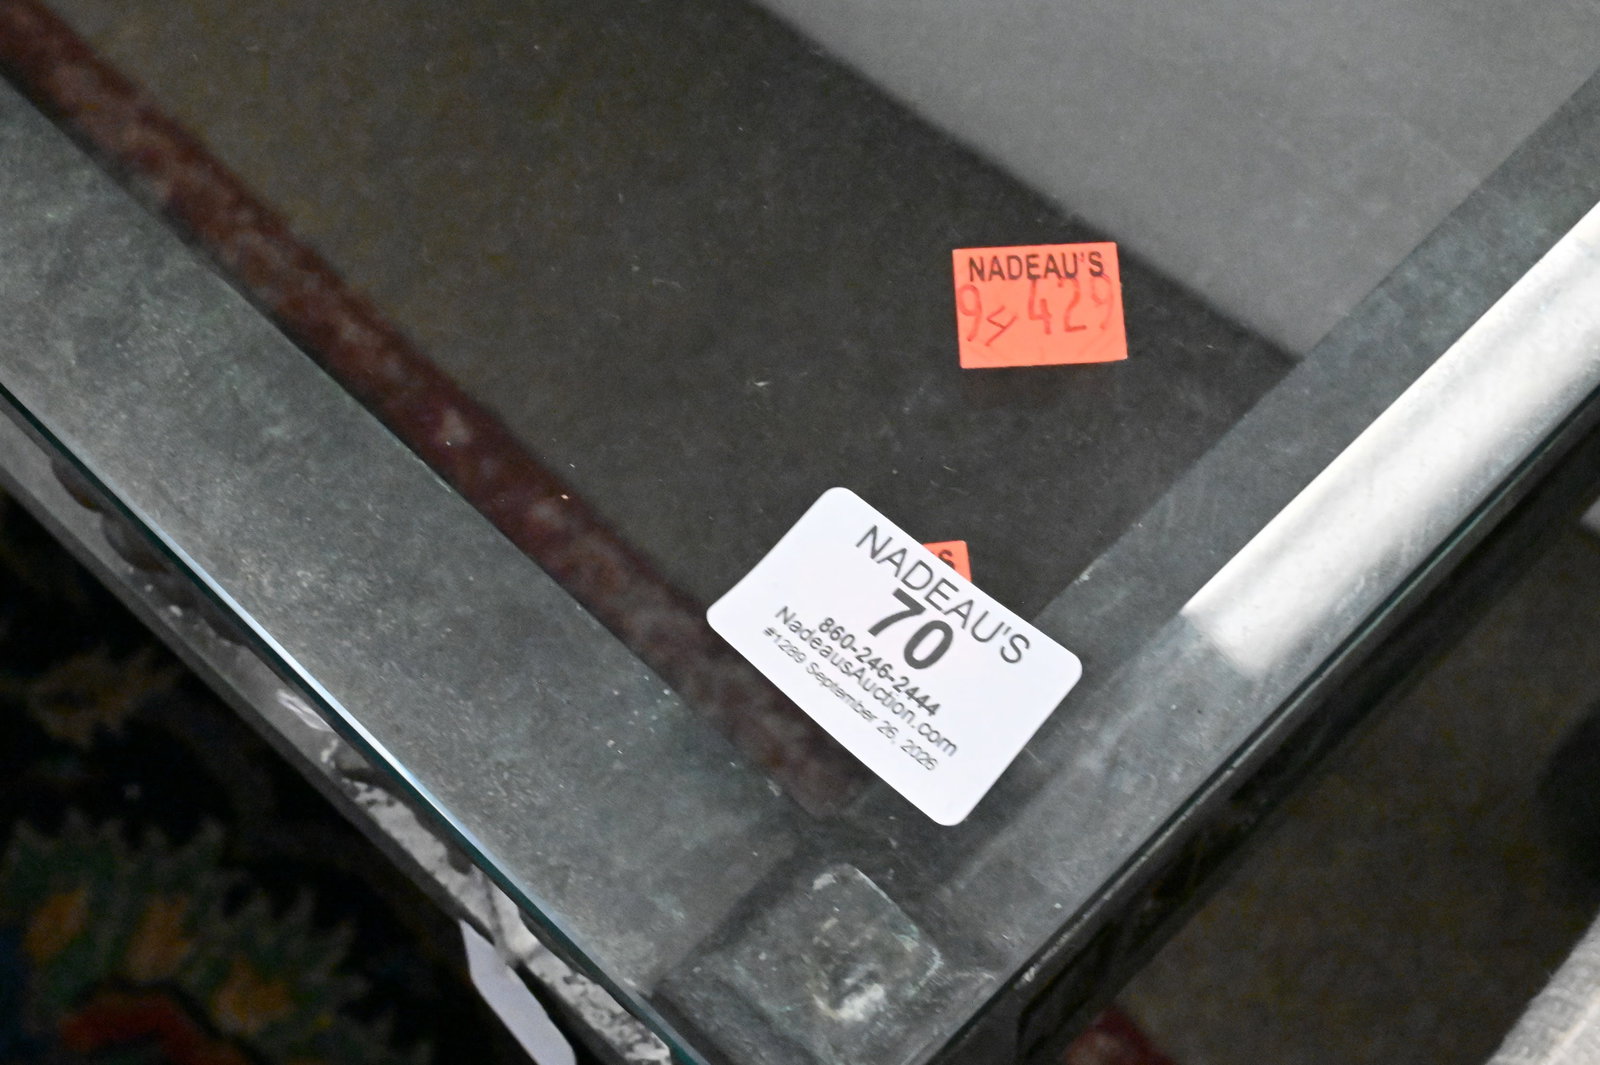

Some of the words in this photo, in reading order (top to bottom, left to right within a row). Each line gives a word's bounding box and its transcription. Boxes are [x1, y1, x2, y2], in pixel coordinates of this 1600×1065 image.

[968, 251, 1105, 282] NADEAU'S
[855, 525, 1032, 665] NADEAU'S
[867, 588, 954, 670] 70
[775, 606, 958, 757] NadeausAuction.com
[806, 662, 878, 723] September
[818, 617, 942, 717] 860-246-2444
